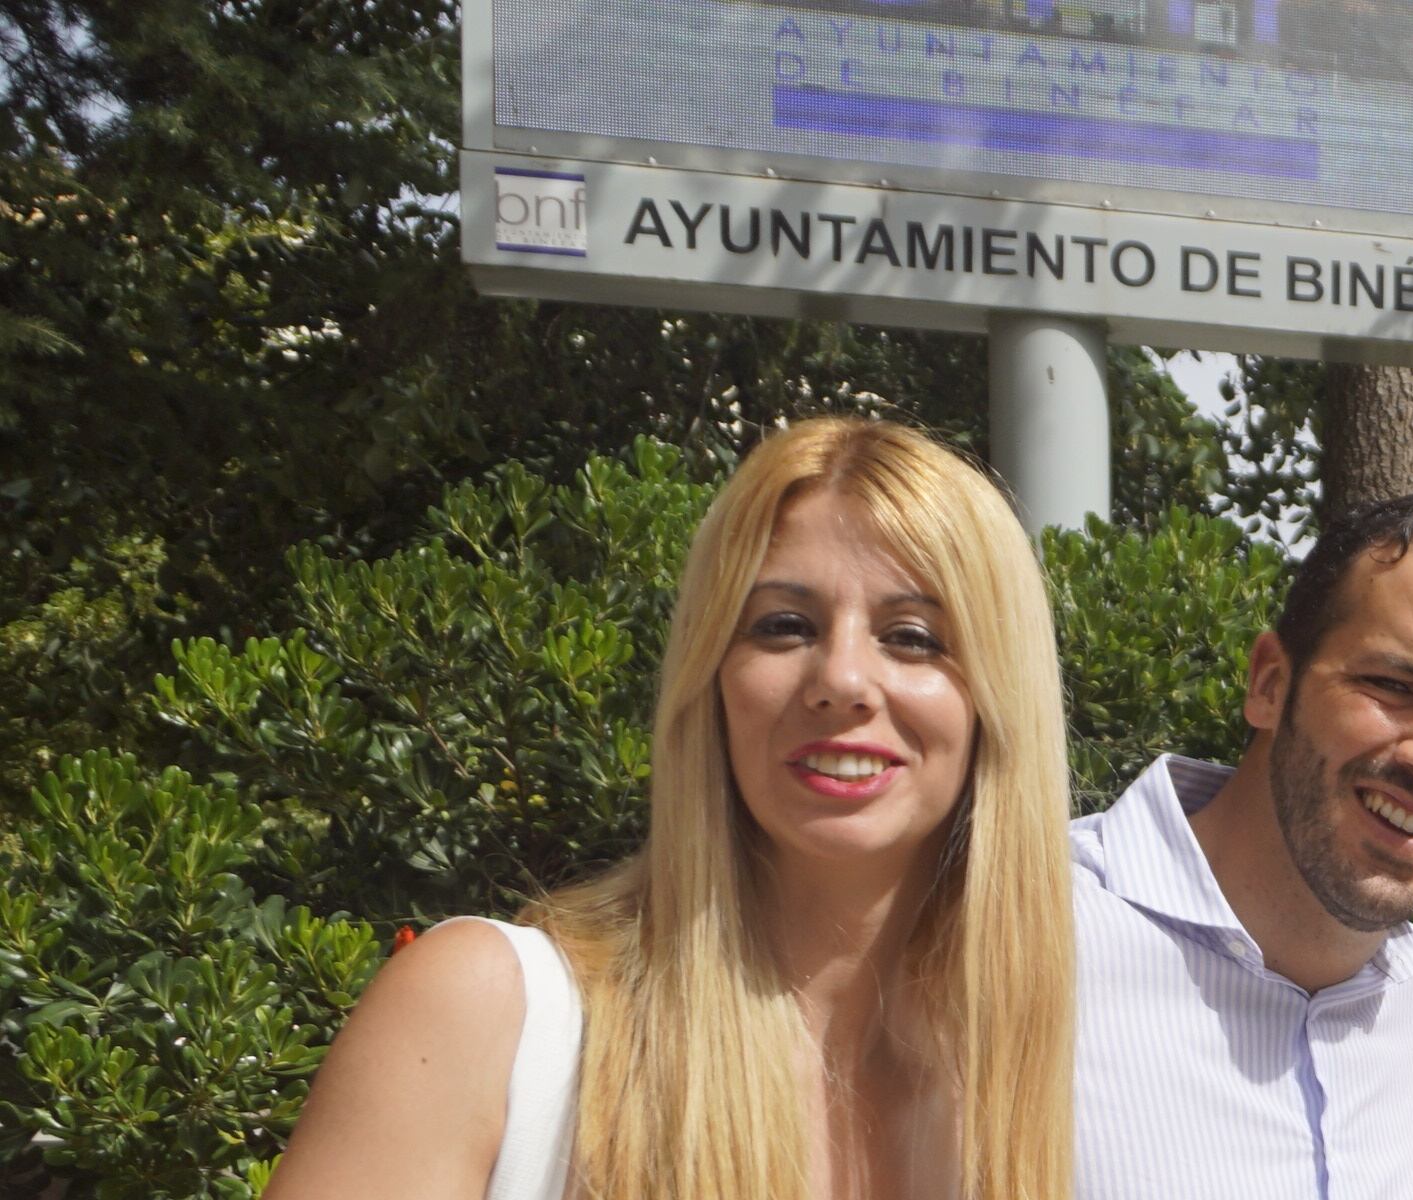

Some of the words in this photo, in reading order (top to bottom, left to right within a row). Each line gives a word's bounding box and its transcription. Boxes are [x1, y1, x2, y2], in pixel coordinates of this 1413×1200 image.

[775, 17, 1319, 97] AYUNTAMIENTO
[775, 50, 864, 88] DE
[495, 180, 586, 230] bnf
[624, 197, 1156, 288] AYUNTAMIENTO
[1180, 244, 1262, 299] DE
